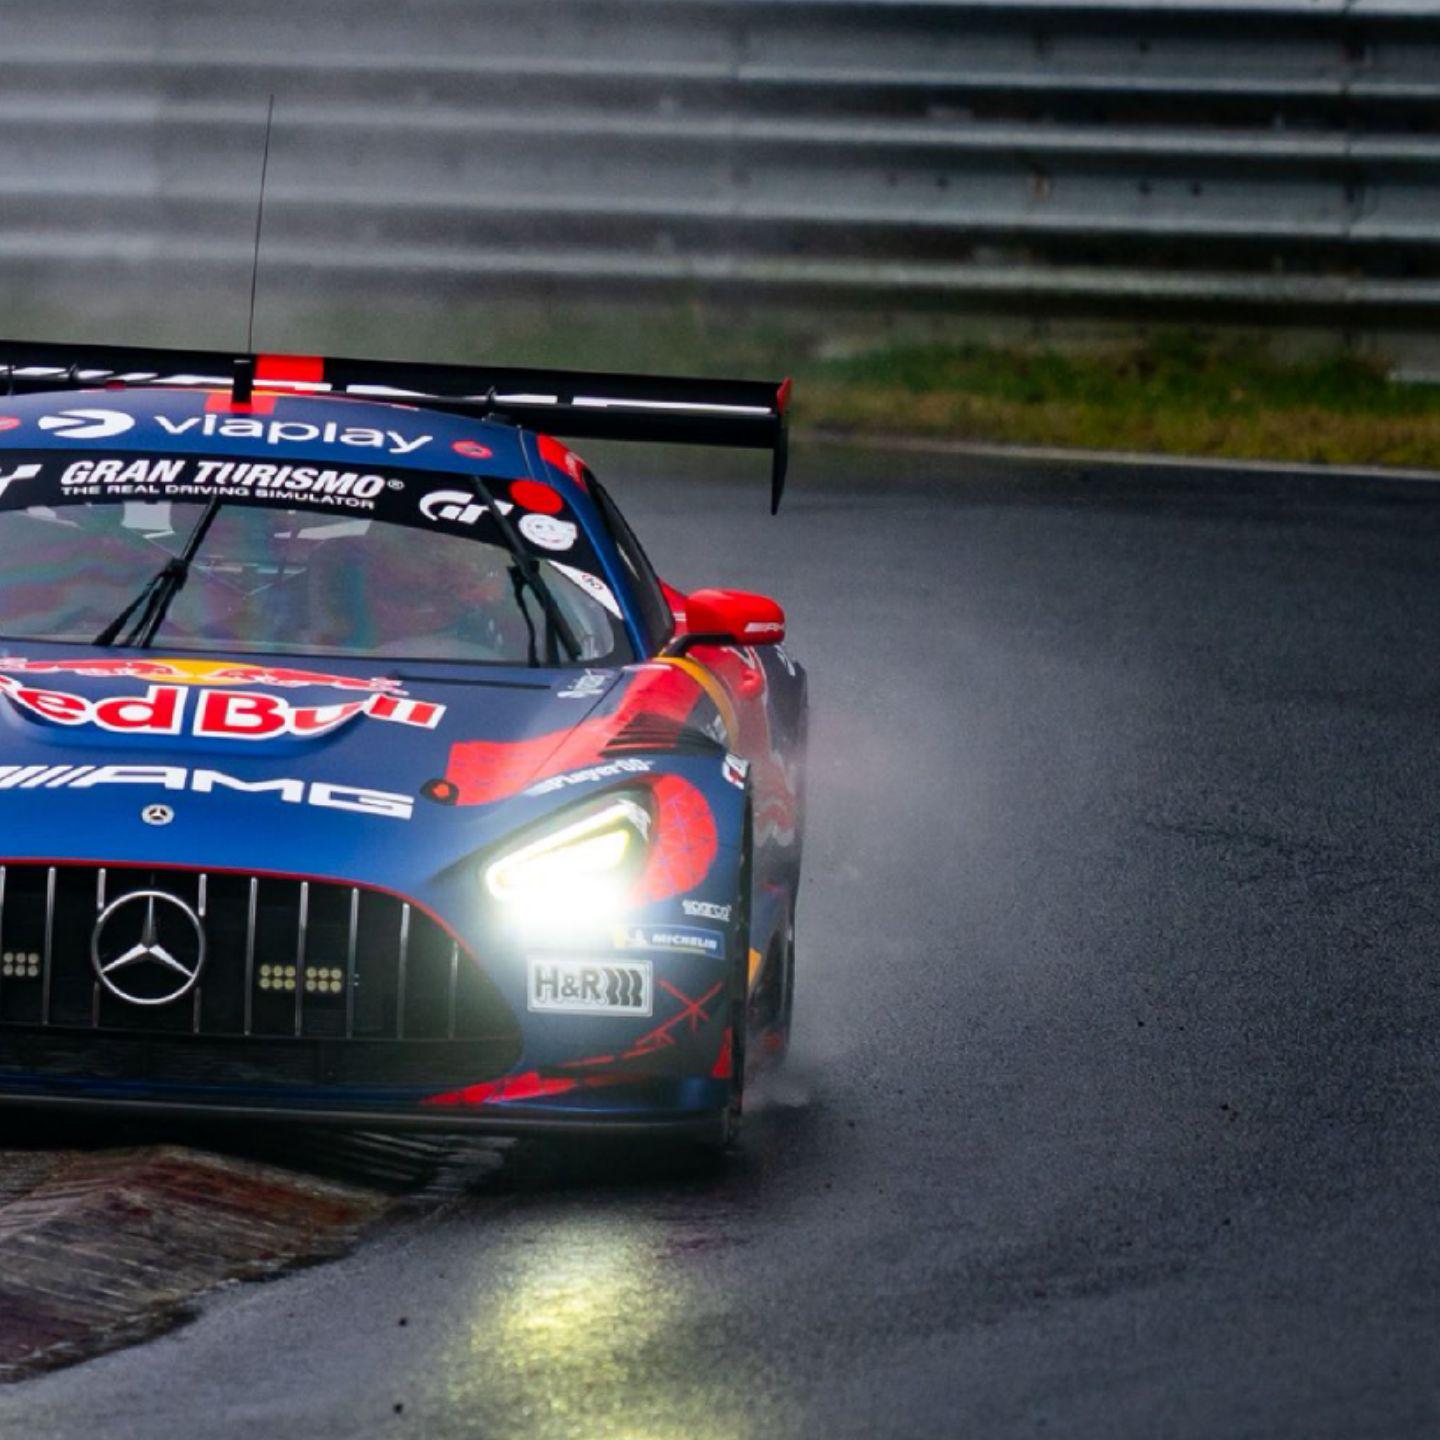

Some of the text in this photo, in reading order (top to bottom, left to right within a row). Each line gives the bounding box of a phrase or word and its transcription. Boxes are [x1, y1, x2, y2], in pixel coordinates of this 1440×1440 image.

[155, 413, 434, 454] viaplay
[61, 459, 186, 486] GRAN
[62, 484, 376, 510] THE REAL DRIVING SIMULATOR
[192, 689, 448, 740] Bull
[650, 933, 719, 951] MICHELIN
[533, 964, 602, 1000] H&R
